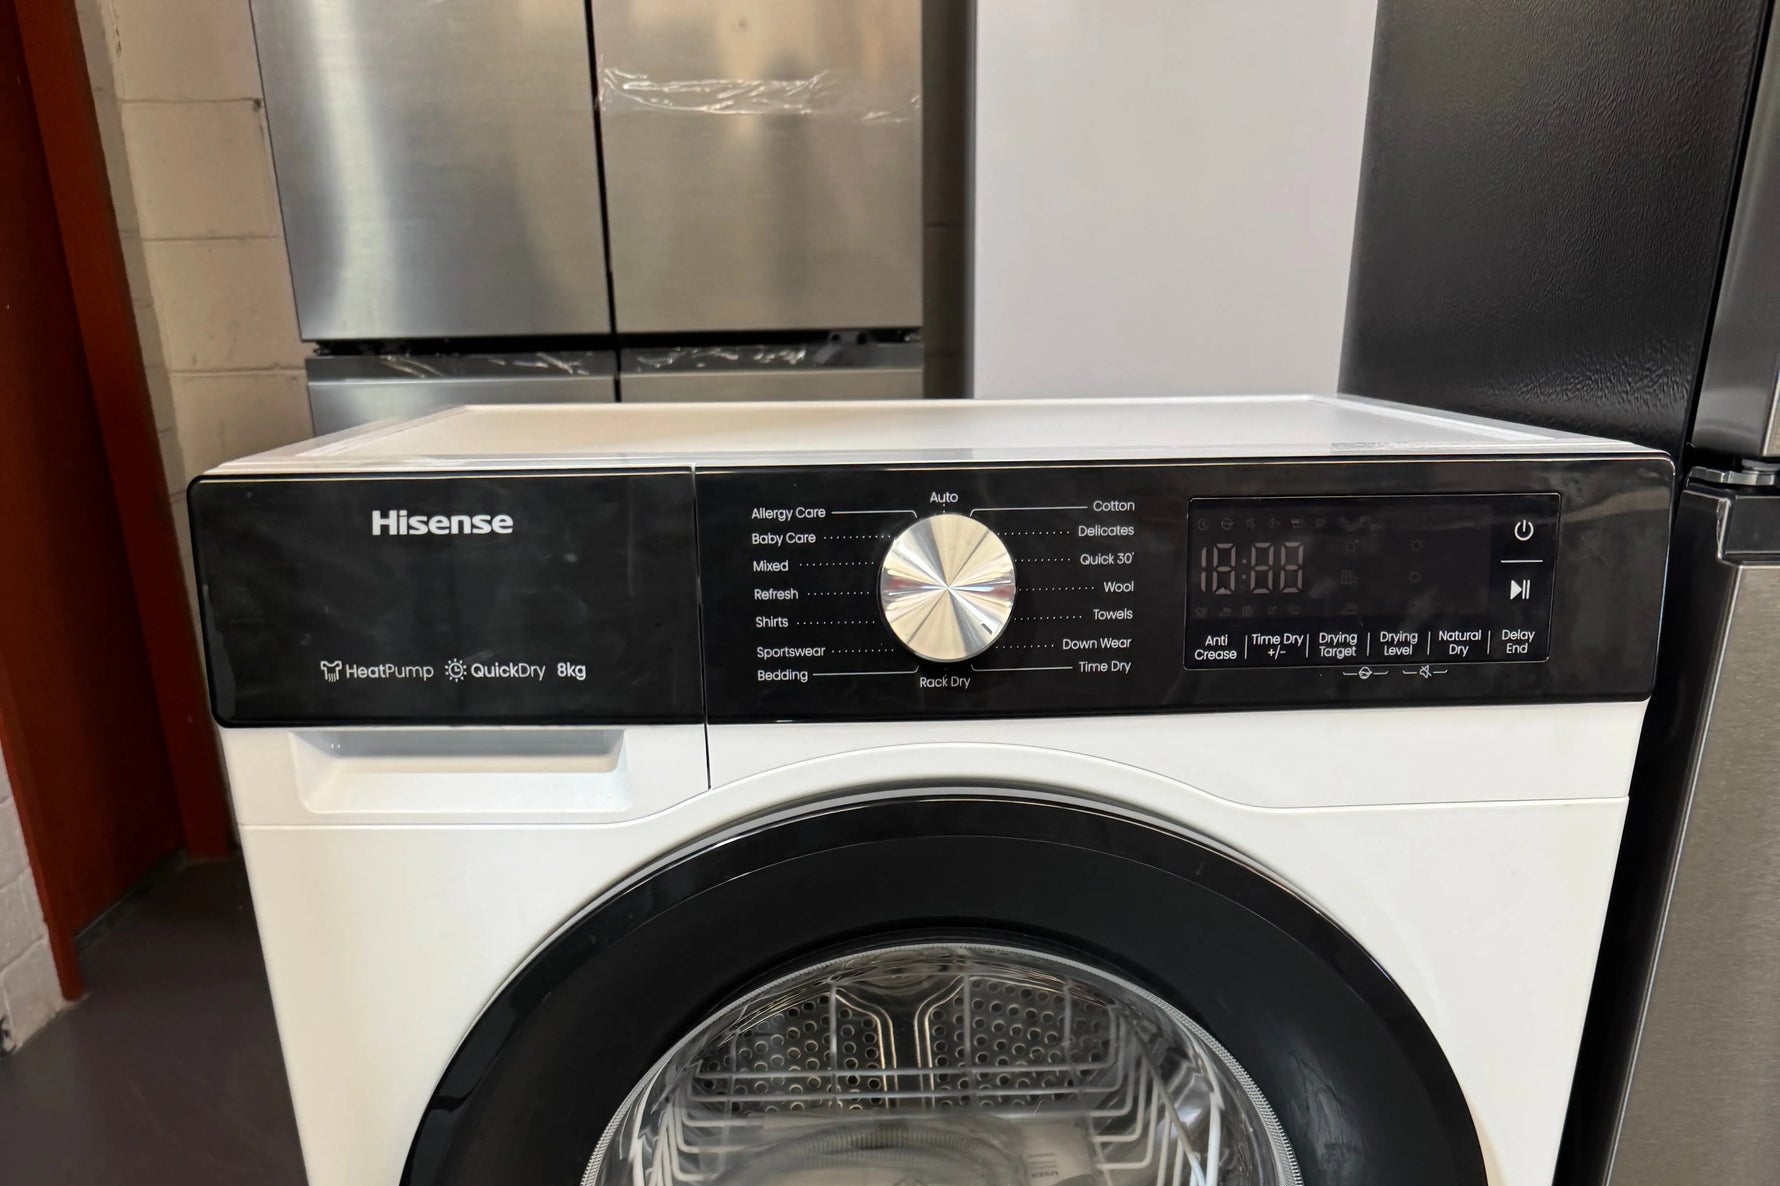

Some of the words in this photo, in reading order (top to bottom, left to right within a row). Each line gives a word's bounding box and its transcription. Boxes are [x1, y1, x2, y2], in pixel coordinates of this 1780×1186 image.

[929, 491, 959, 504] Auto
[1092, 500, 1136, 512] Cotton
[751, 507, 794, 522] Allergy
[795, 506, 826, 519] Care
[372, 509, 514, 536] Hisense
[1078, 524, 1135, 537] Delicates
[751, 532, 784, 547] Baby
[785, 532, 817, 544] Care
[752, 559, 789, 572] Mixed
[1079, 552, 1115, 566] Quick
[1103, 580, 1135, 593] Wool
[754, 587, 799, 601] Refresh
[1092, 607, 1134, 621] Towels
[755, 615, 789, 628] Shirts
[1204, 634, 1229, 647] Anti
[1251, 633, 1281, 647] Time
[1283, 632, 1305, 647] Dry
[1318, 631, 1358, 646] Drying
[1379, 630, 1419, 645] Drying
[1438, 629, 1482, 642] Natural
[1501, 628, 1536, 643] Delay
[1062, 638, 1098, 650] Down
[1099, 637, 1132, 649] Wear
[1383, 642, 1415, 656] Level
[1448, 643, 1470, 658] Dry
[1506, 640, 1531, 654] End
[756, 646, 826, 660] Sportswear
[1194, 648, 1238, 661] Crease
[1318, 643, 1357, 659] Target
[345, 663, 435, 682] HeatPump
[470, 661, 546, 681] QuickDry
[557, 661, 587, 681] 8kg
[1078, 661, 1109, 673] Time
[1111, 660, 1132, 674] Dry
[757, 668, 809, 683] Bedding
[919, 674, 948, 688] Rack
[950, 675, 971, 690] Dry
